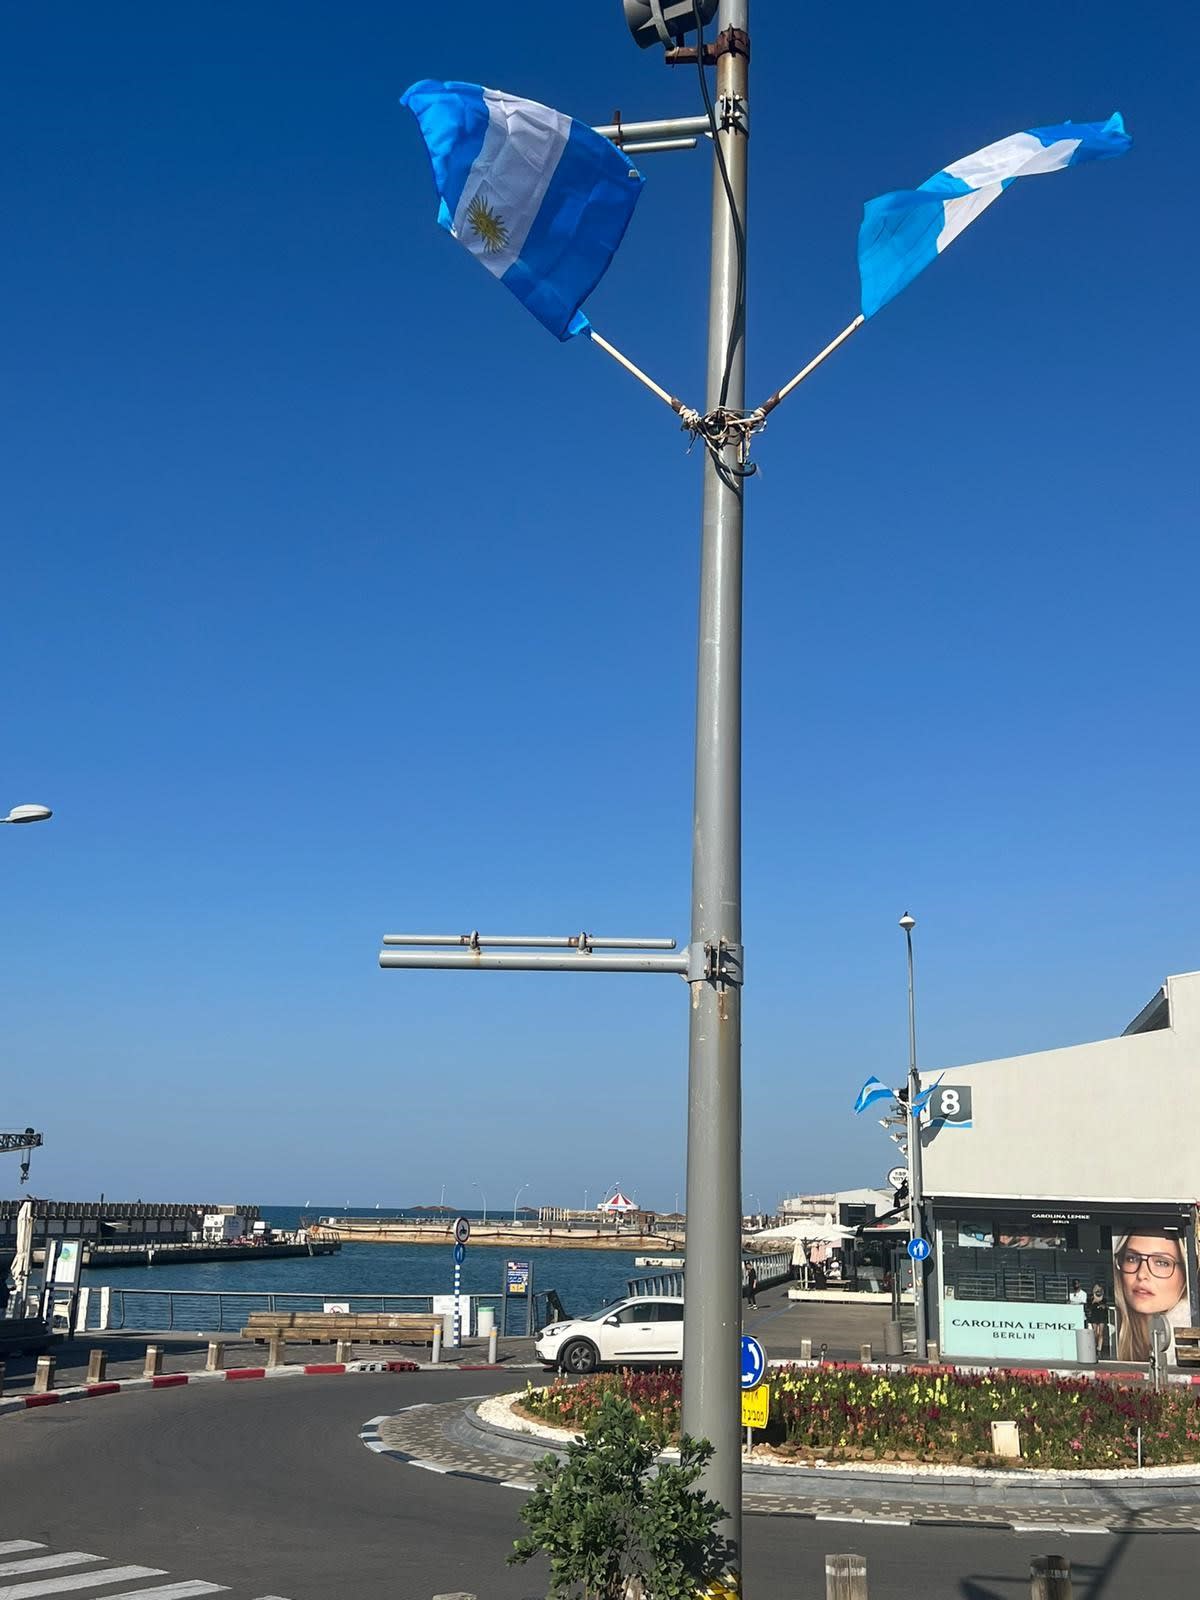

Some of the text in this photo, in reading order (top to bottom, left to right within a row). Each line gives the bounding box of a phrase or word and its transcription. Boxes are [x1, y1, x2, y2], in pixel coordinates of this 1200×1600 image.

[941, 1089, 960, 1115] 8
[952, 1319, 1076, 1330] CAROLINA LEMKE
[992, 1331, 1035, 1340] BERLIN
